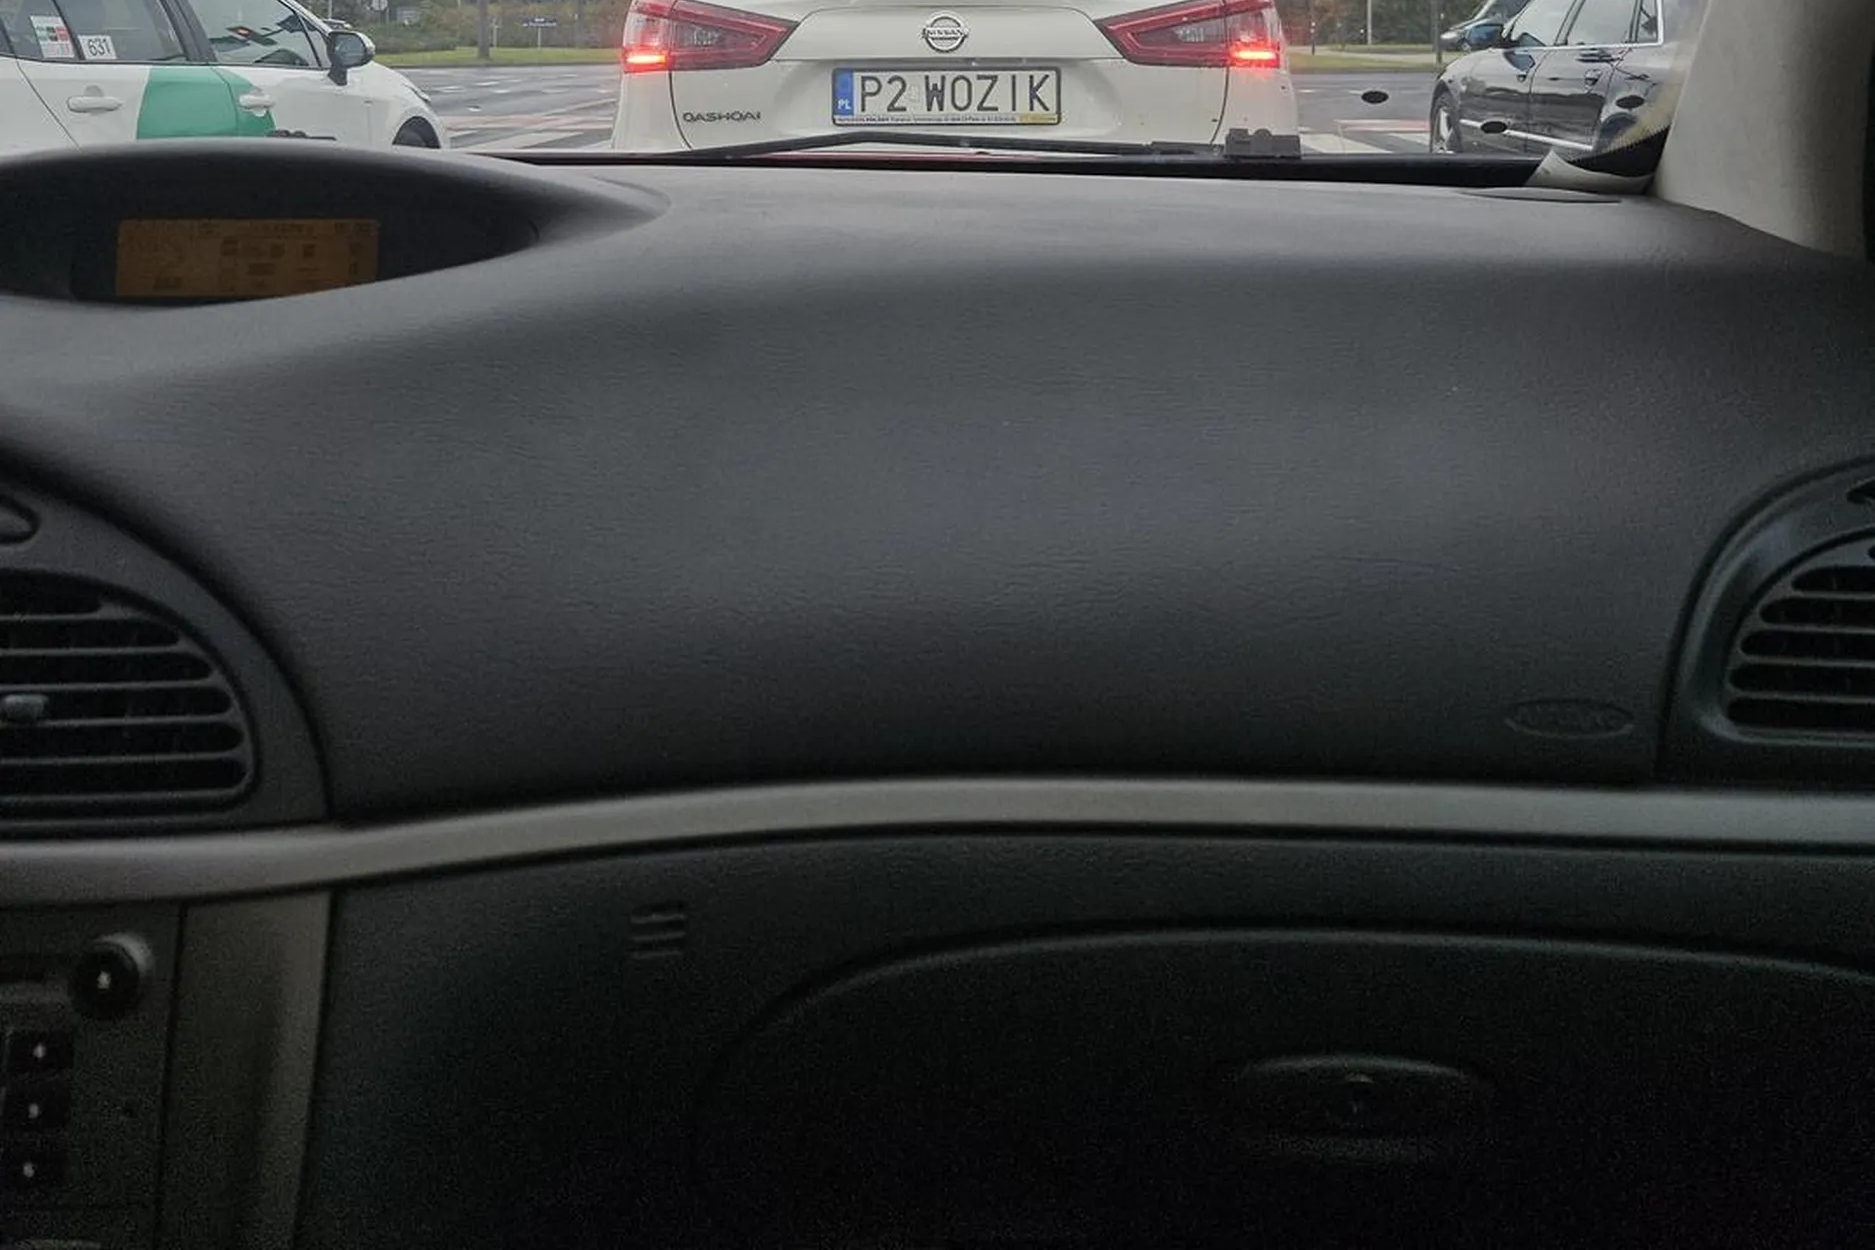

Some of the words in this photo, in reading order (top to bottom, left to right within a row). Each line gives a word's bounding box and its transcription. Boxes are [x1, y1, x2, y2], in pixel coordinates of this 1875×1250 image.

[87, 38, 111, 56] 631
[860, 74, 907, 112] P2
[924, 74, 1050, 112] WOZIK
